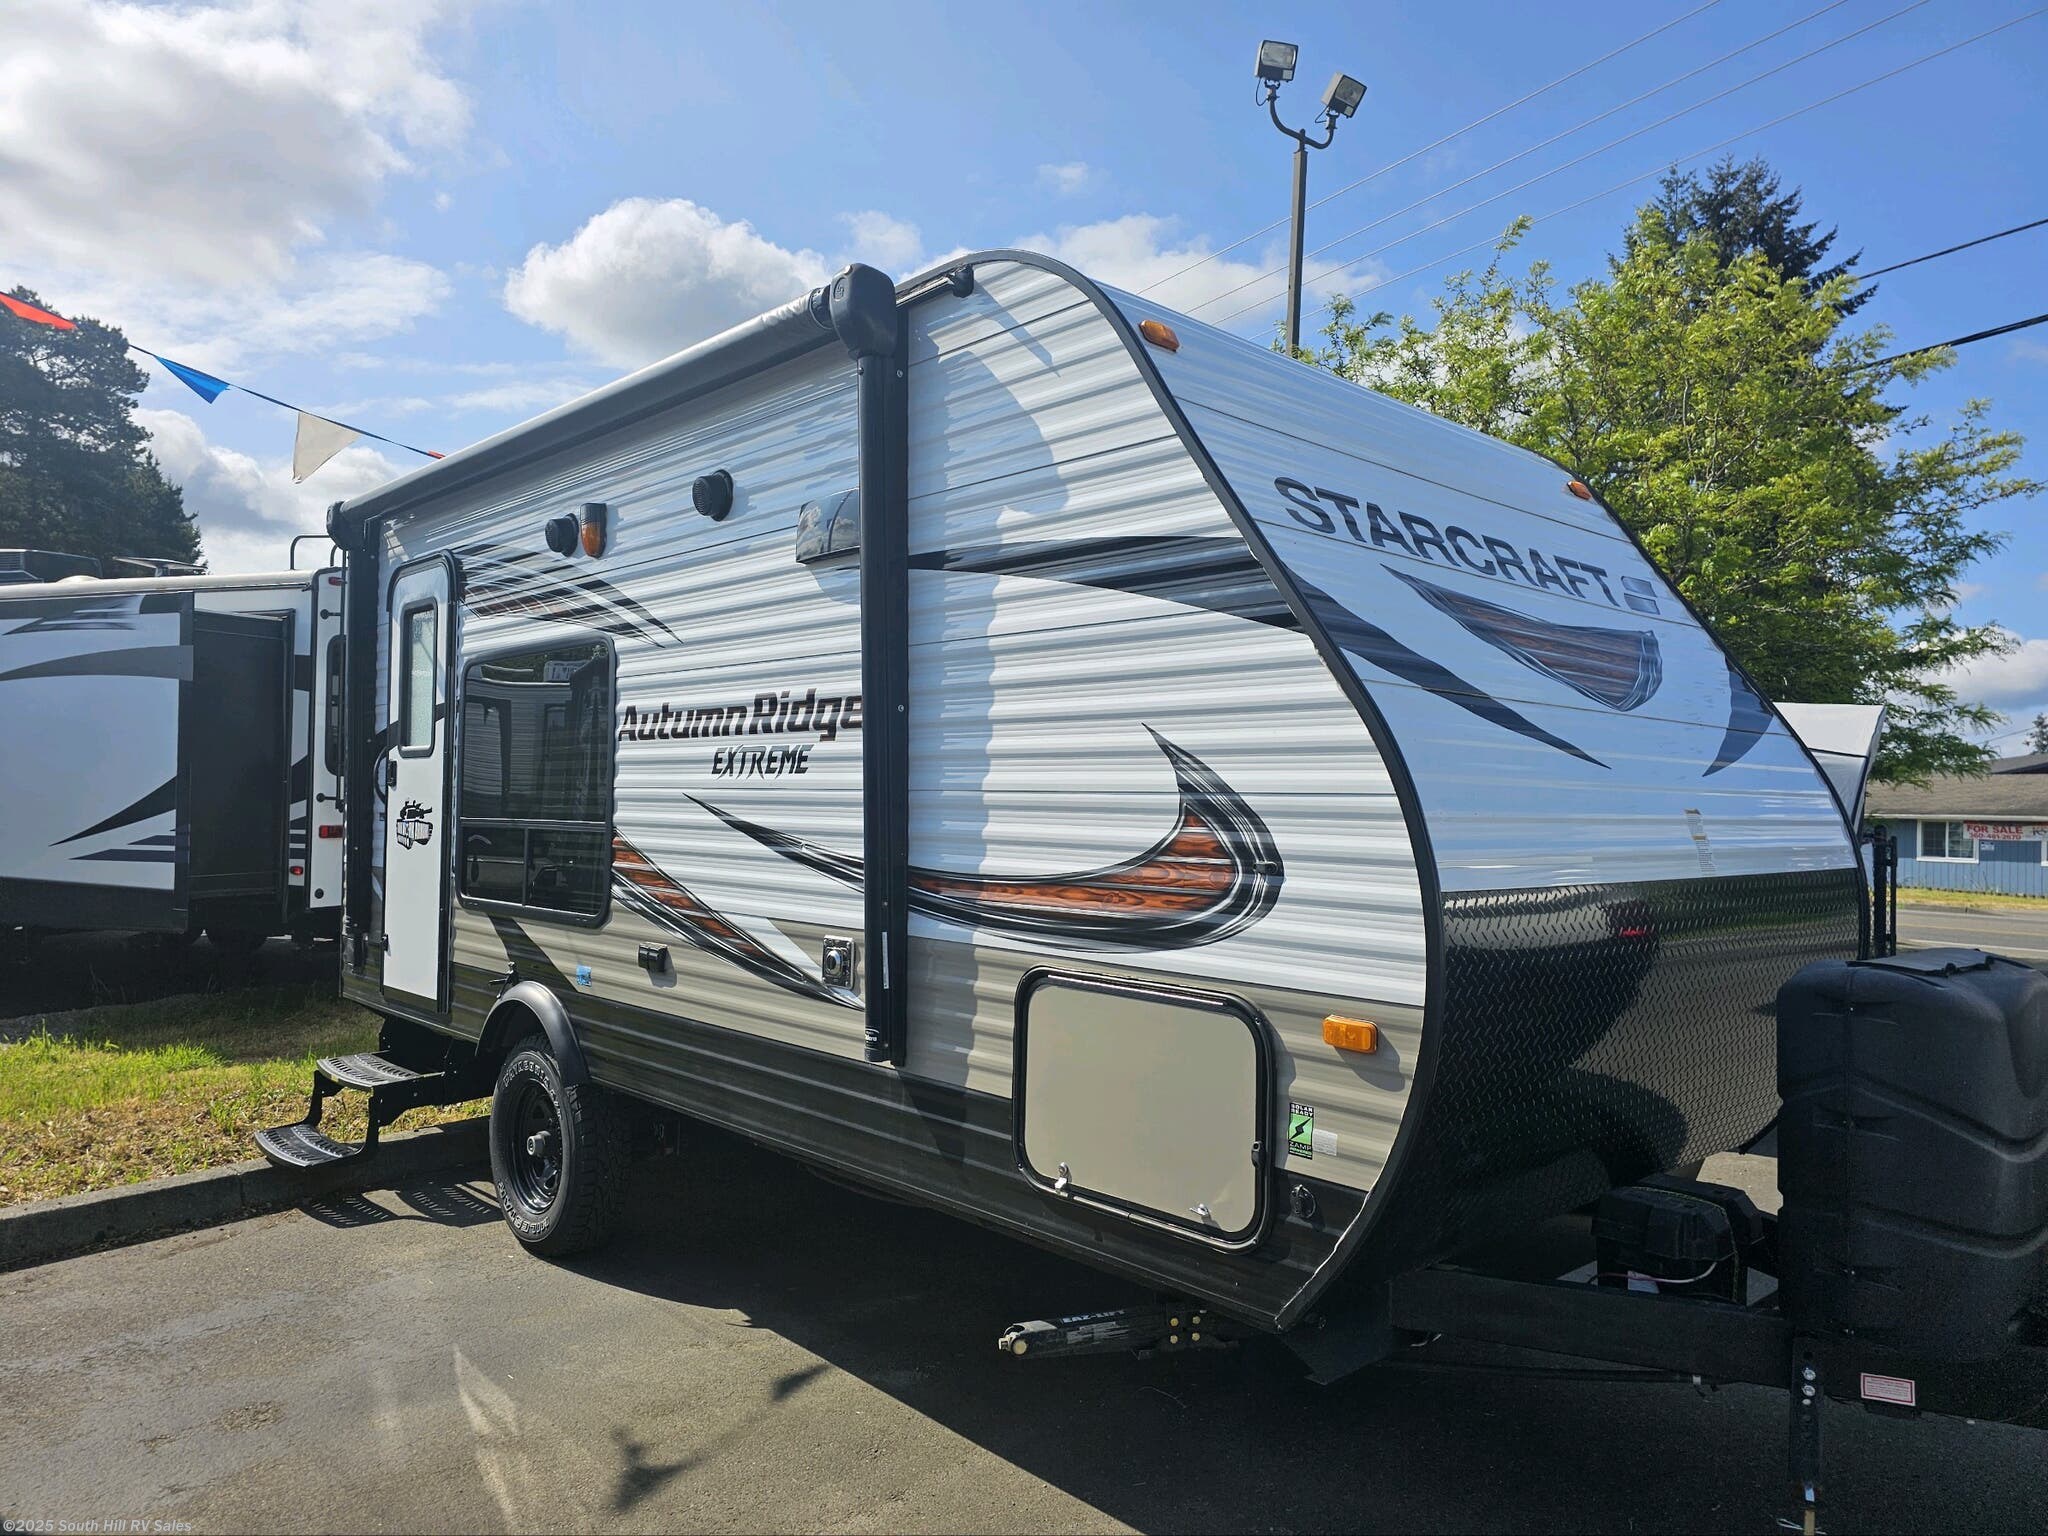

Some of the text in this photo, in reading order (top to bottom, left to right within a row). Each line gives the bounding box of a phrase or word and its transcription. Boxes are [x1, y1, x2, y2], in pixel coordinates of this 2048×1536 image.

[1274, 476, 1621, 608] STARCRAFT
[711, 744, 815, 780] EXTREME
[1966, 823, 2024, 834] FOR SALE
[1291, 1103, 1313, 1113] SOLAR
[1291, 1109, 1314, 1117] READY
[1289, 1141, 1312, 1151] ZAMP
